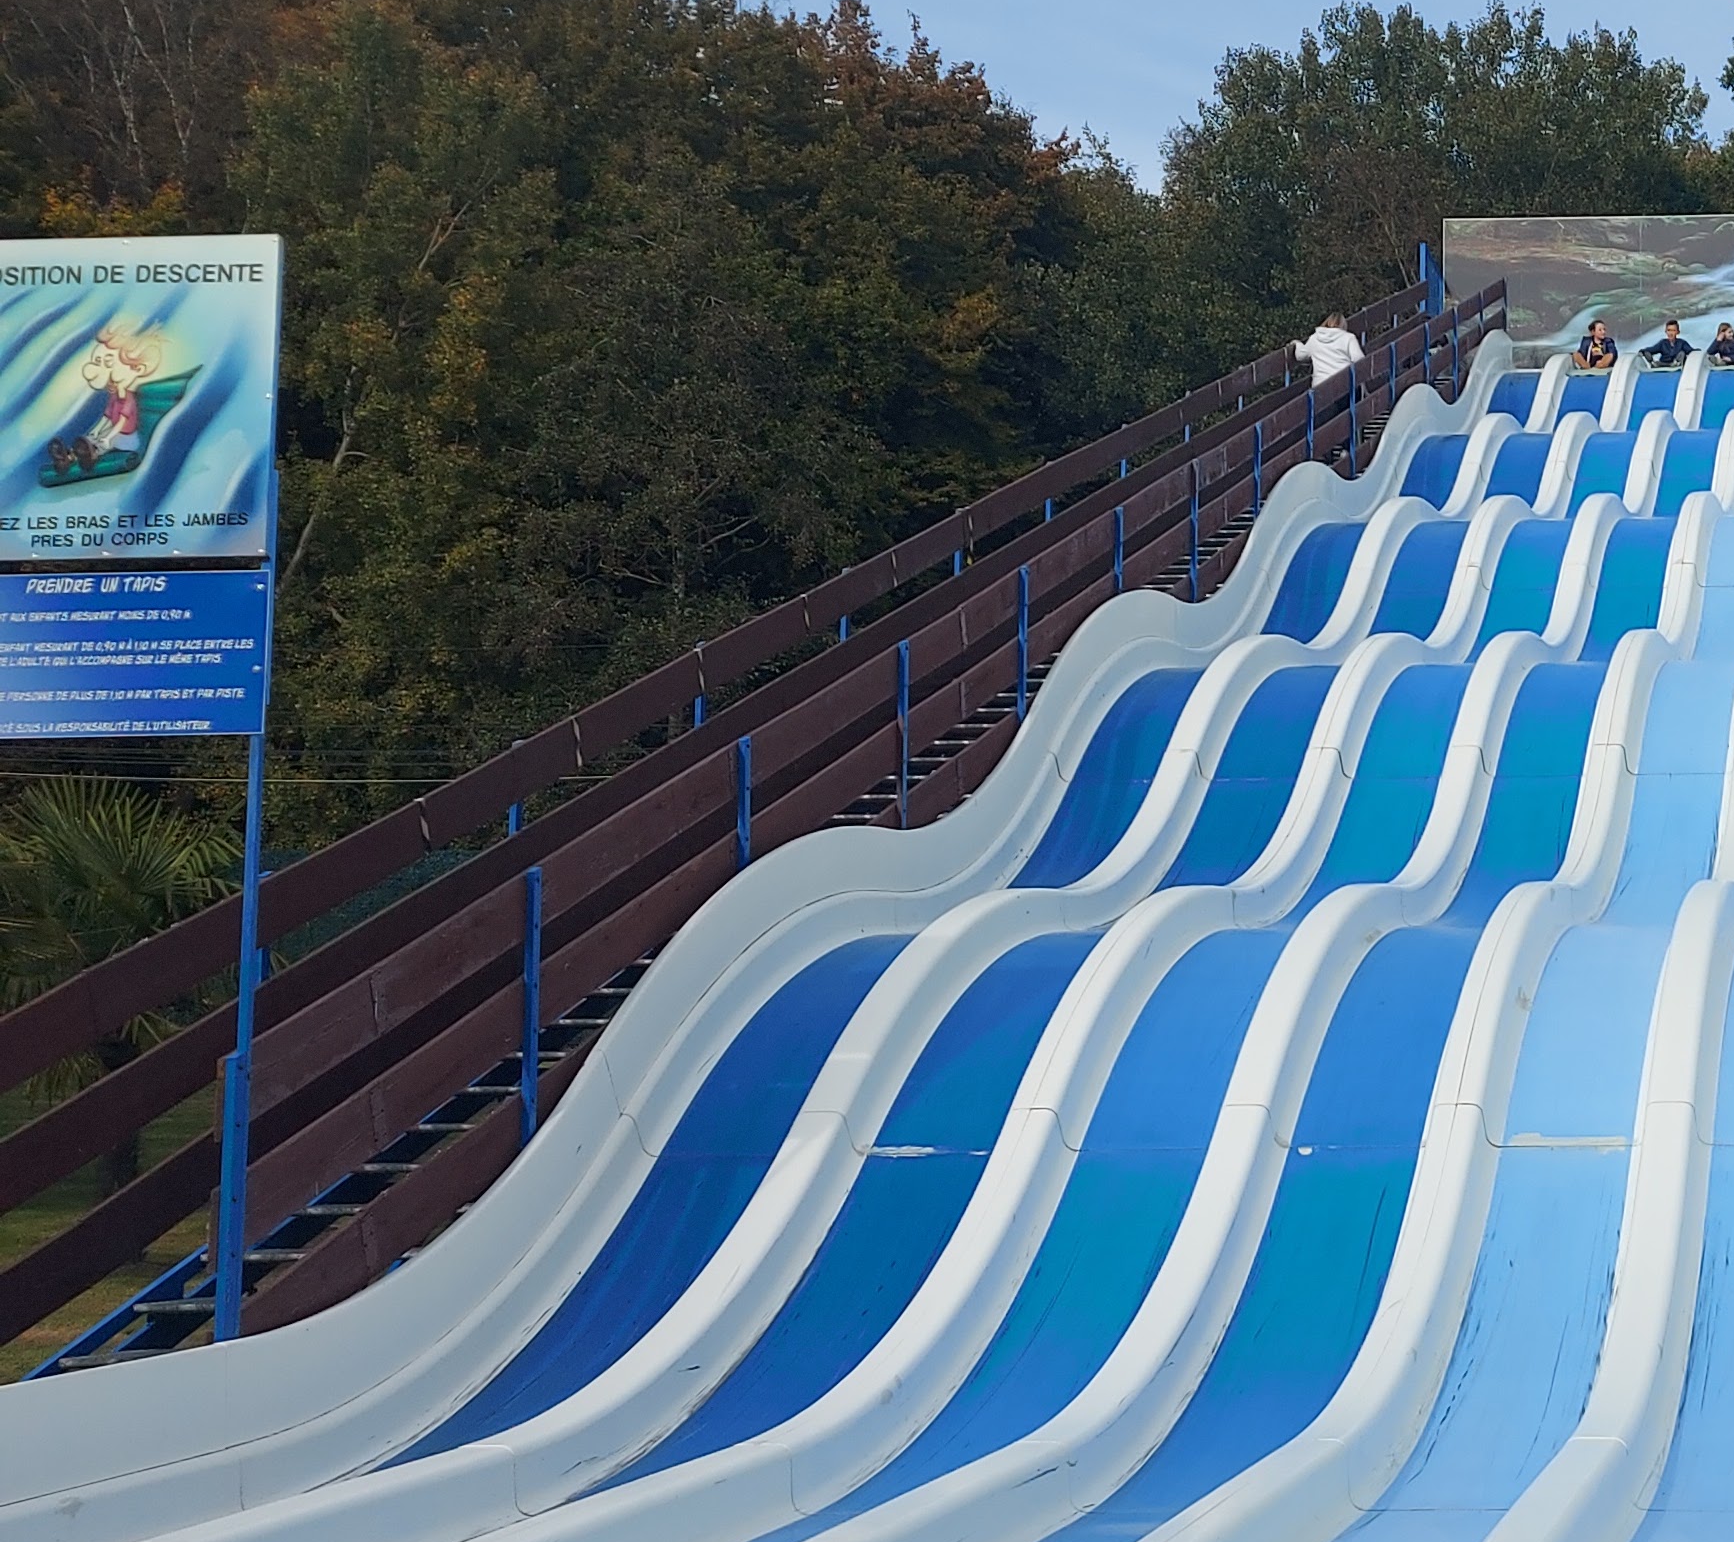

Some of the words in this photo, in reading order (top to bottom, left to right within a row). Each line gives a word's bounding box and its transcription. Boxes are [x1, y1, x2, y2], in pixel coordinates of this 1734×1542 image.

[93, 265, 125, 284] DE
[136, 264, 263, 284] DESCENTE
[27, 516, 58, 530] LES
[66, 515, 110, 529] BRAS
[118, 515, 138, 528] ET
[145, 514, 175, 528] LES
[182, 512, 249, 527] JAMBES
[31, 534, 74, 548] PRES
[81, 533, 104, 546] DU
[111, 532, 169, 546] CORPS
[26, 577, 96, 594] PRENDRE
[100, 577, 120, 593] UN
[123, 576, 168, 593] TAPIS
